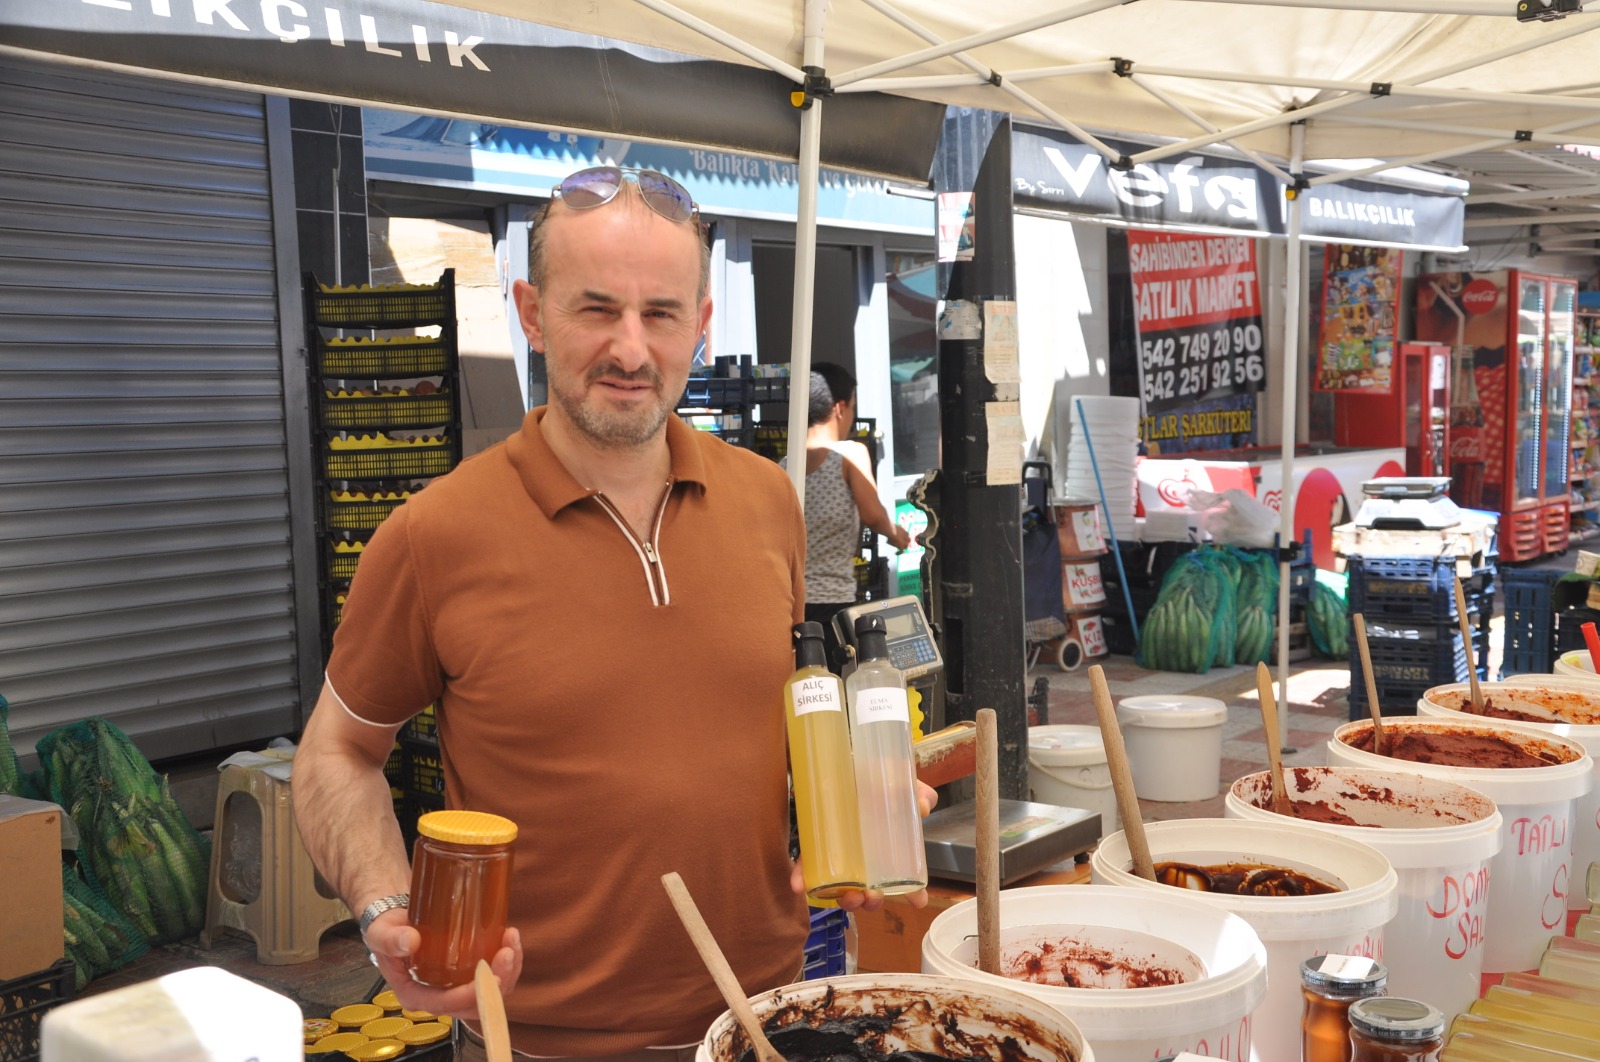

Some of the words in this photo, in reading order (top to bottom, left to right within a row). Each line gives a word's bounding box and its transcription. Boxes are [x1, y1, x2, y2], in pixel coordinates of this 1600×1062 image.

[1014, 177, 1035, 197] By
[1309, 197, 1416, 226] BALIKÇILIK
[1130, 236, 1205, 272] SAHİBİNDEN
[1195, 271, 1256, 314] MARKET
[1180, 332, 1210, 363] 749
[1213, 329, 1230, 357] 20
[1234, 324, 1262, 352] 90
[1144, 370, 1175, 404] 542
[1180, 366, 1208, 396] 251
[1213, 360, 1231, 389] 92
[1235, 355, 1264, 385] 56
[797, 692, 833, 707] SİRKESİ
[803, 680, 824, 692] ALIÇ
